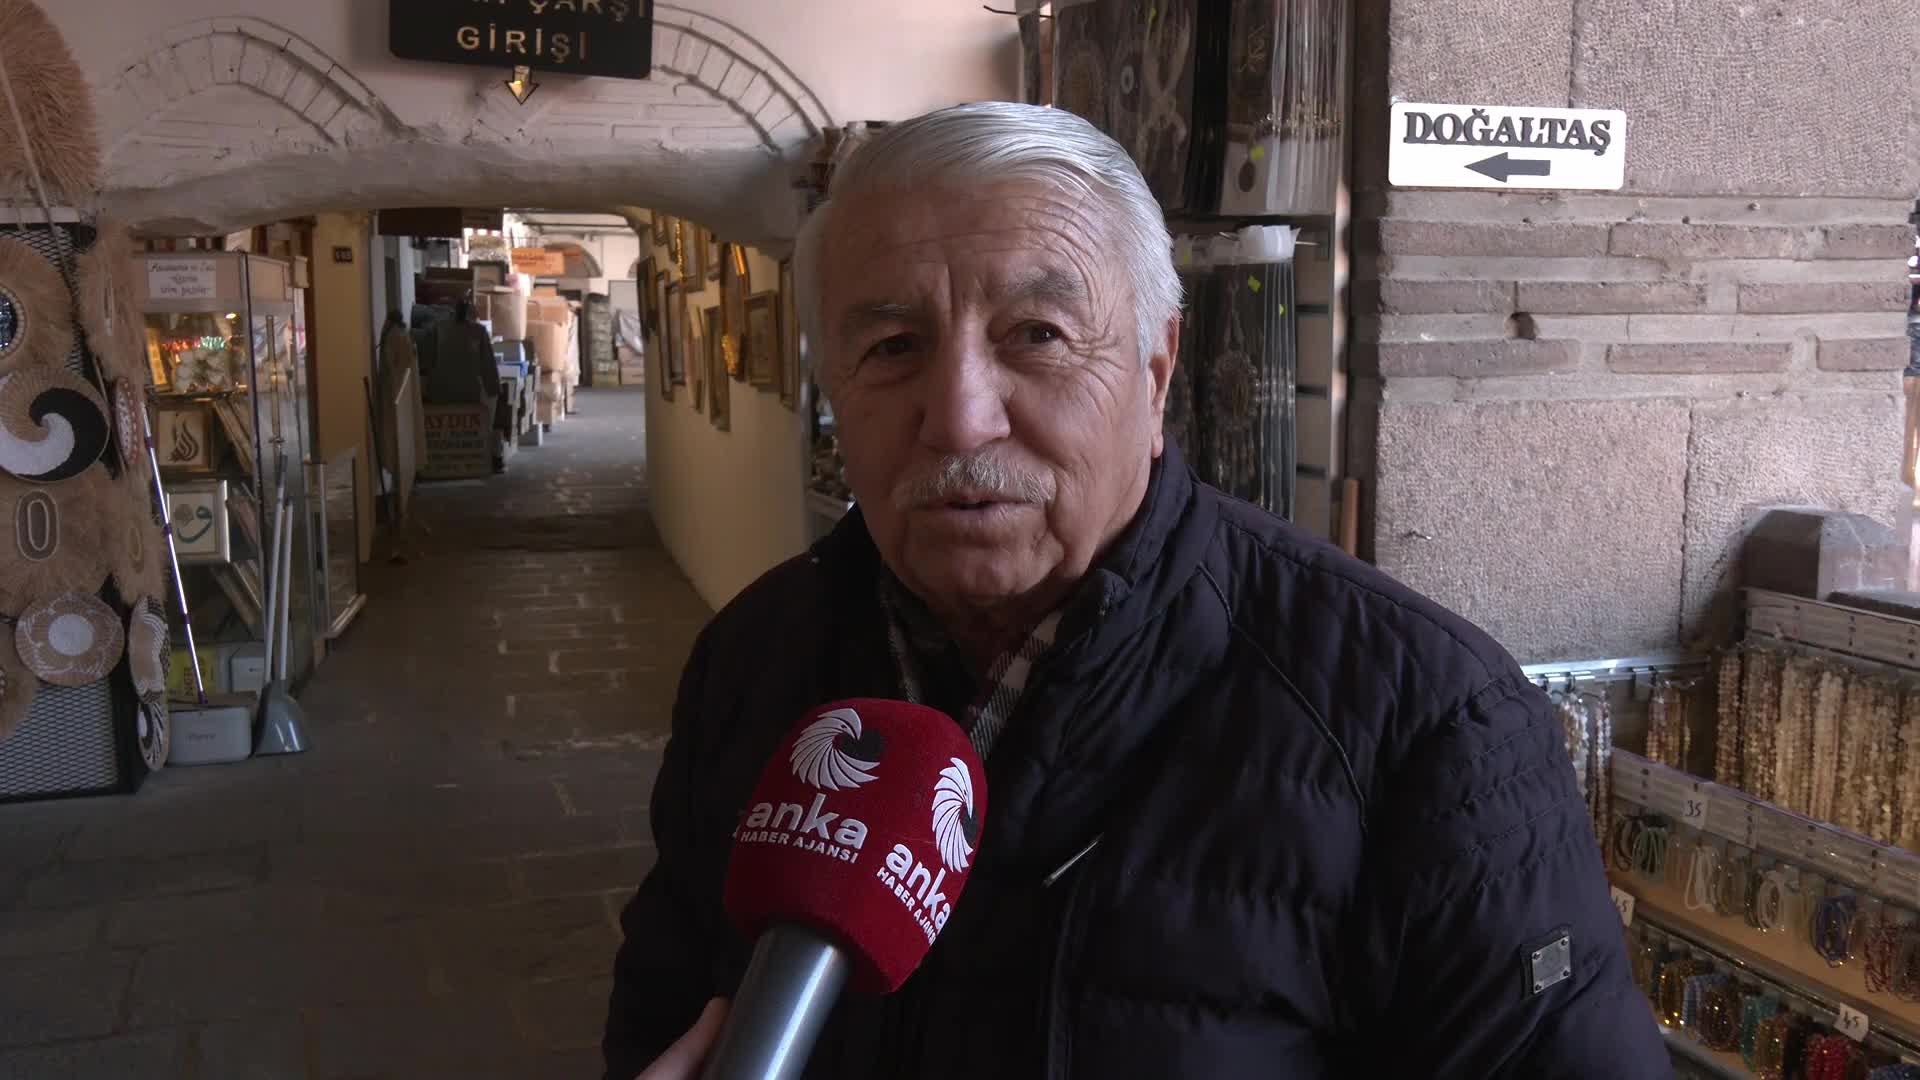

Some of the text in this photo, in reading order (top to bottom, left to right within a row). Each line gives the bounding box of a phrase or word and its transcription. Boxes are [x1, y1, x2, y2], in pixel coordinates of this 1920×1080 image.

[1403, 108, 1612, 157] DOĞALTAŞ
[746, 793, 868, 849] anka
[1685, 799, 1702, 817] 35
[740, 831, 859, 864] HABER AJANSI
[876, 866, 916, 912] HABER
[885, 843, 951, 935] anka
